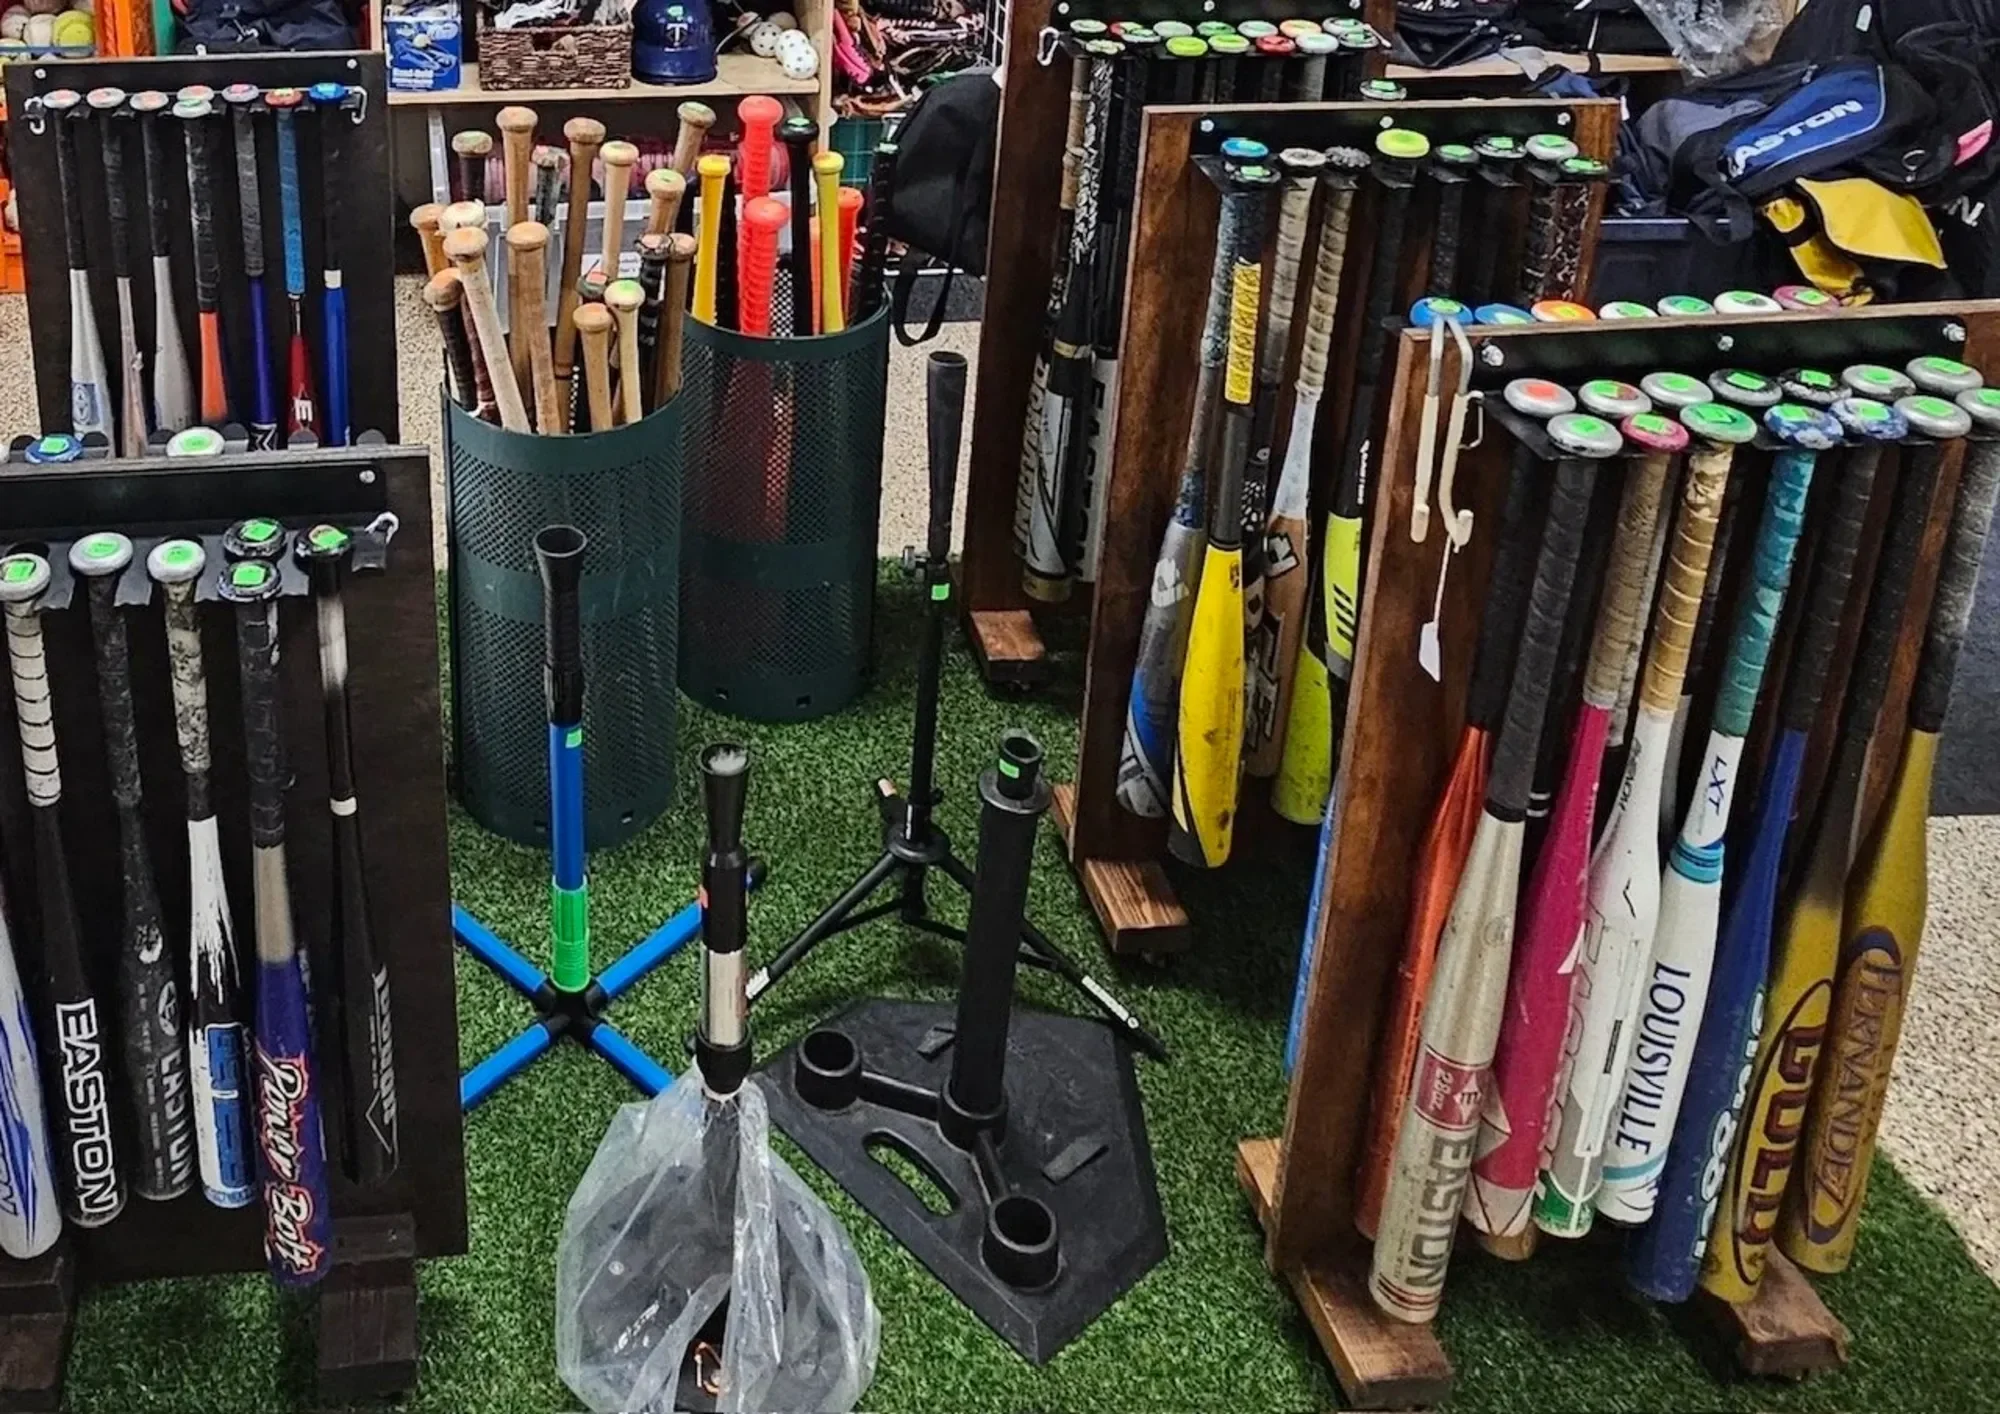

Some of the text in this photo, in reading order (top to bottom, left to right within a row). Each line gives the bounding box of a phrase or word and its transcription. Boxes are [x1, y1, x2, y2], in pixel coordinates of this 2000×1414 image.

[1708, 755, 1727, 816] LXT
[56, 998, 118, 1213] EASTON
[256, 1040, 311, 1270] Power Bolt
[1615, 960, 1692, 1155] LOUISVILLE
[1405, 1134, 1472, 1288] EASTON
